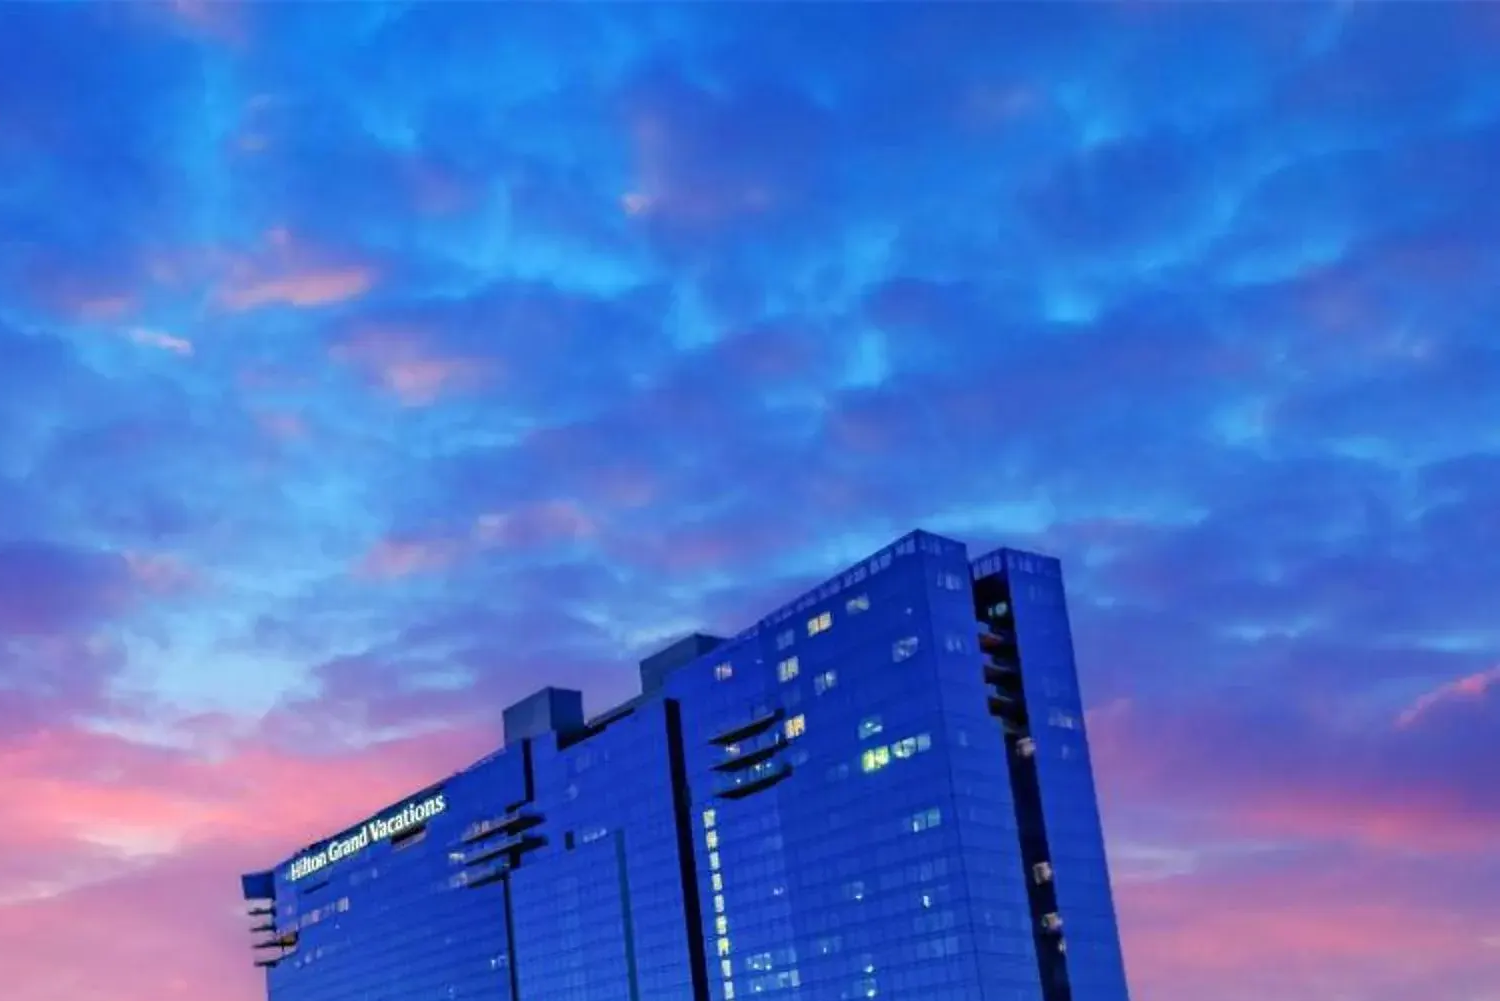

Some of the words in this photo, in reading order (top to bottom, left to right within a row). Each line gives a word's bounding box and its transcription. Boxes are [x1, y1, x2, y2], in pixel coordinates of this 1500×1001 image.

[290, 852, 327, 881] Hilton
[328, 826, 368, 861] Grand
[369, 795, 446, 841] Vacations
